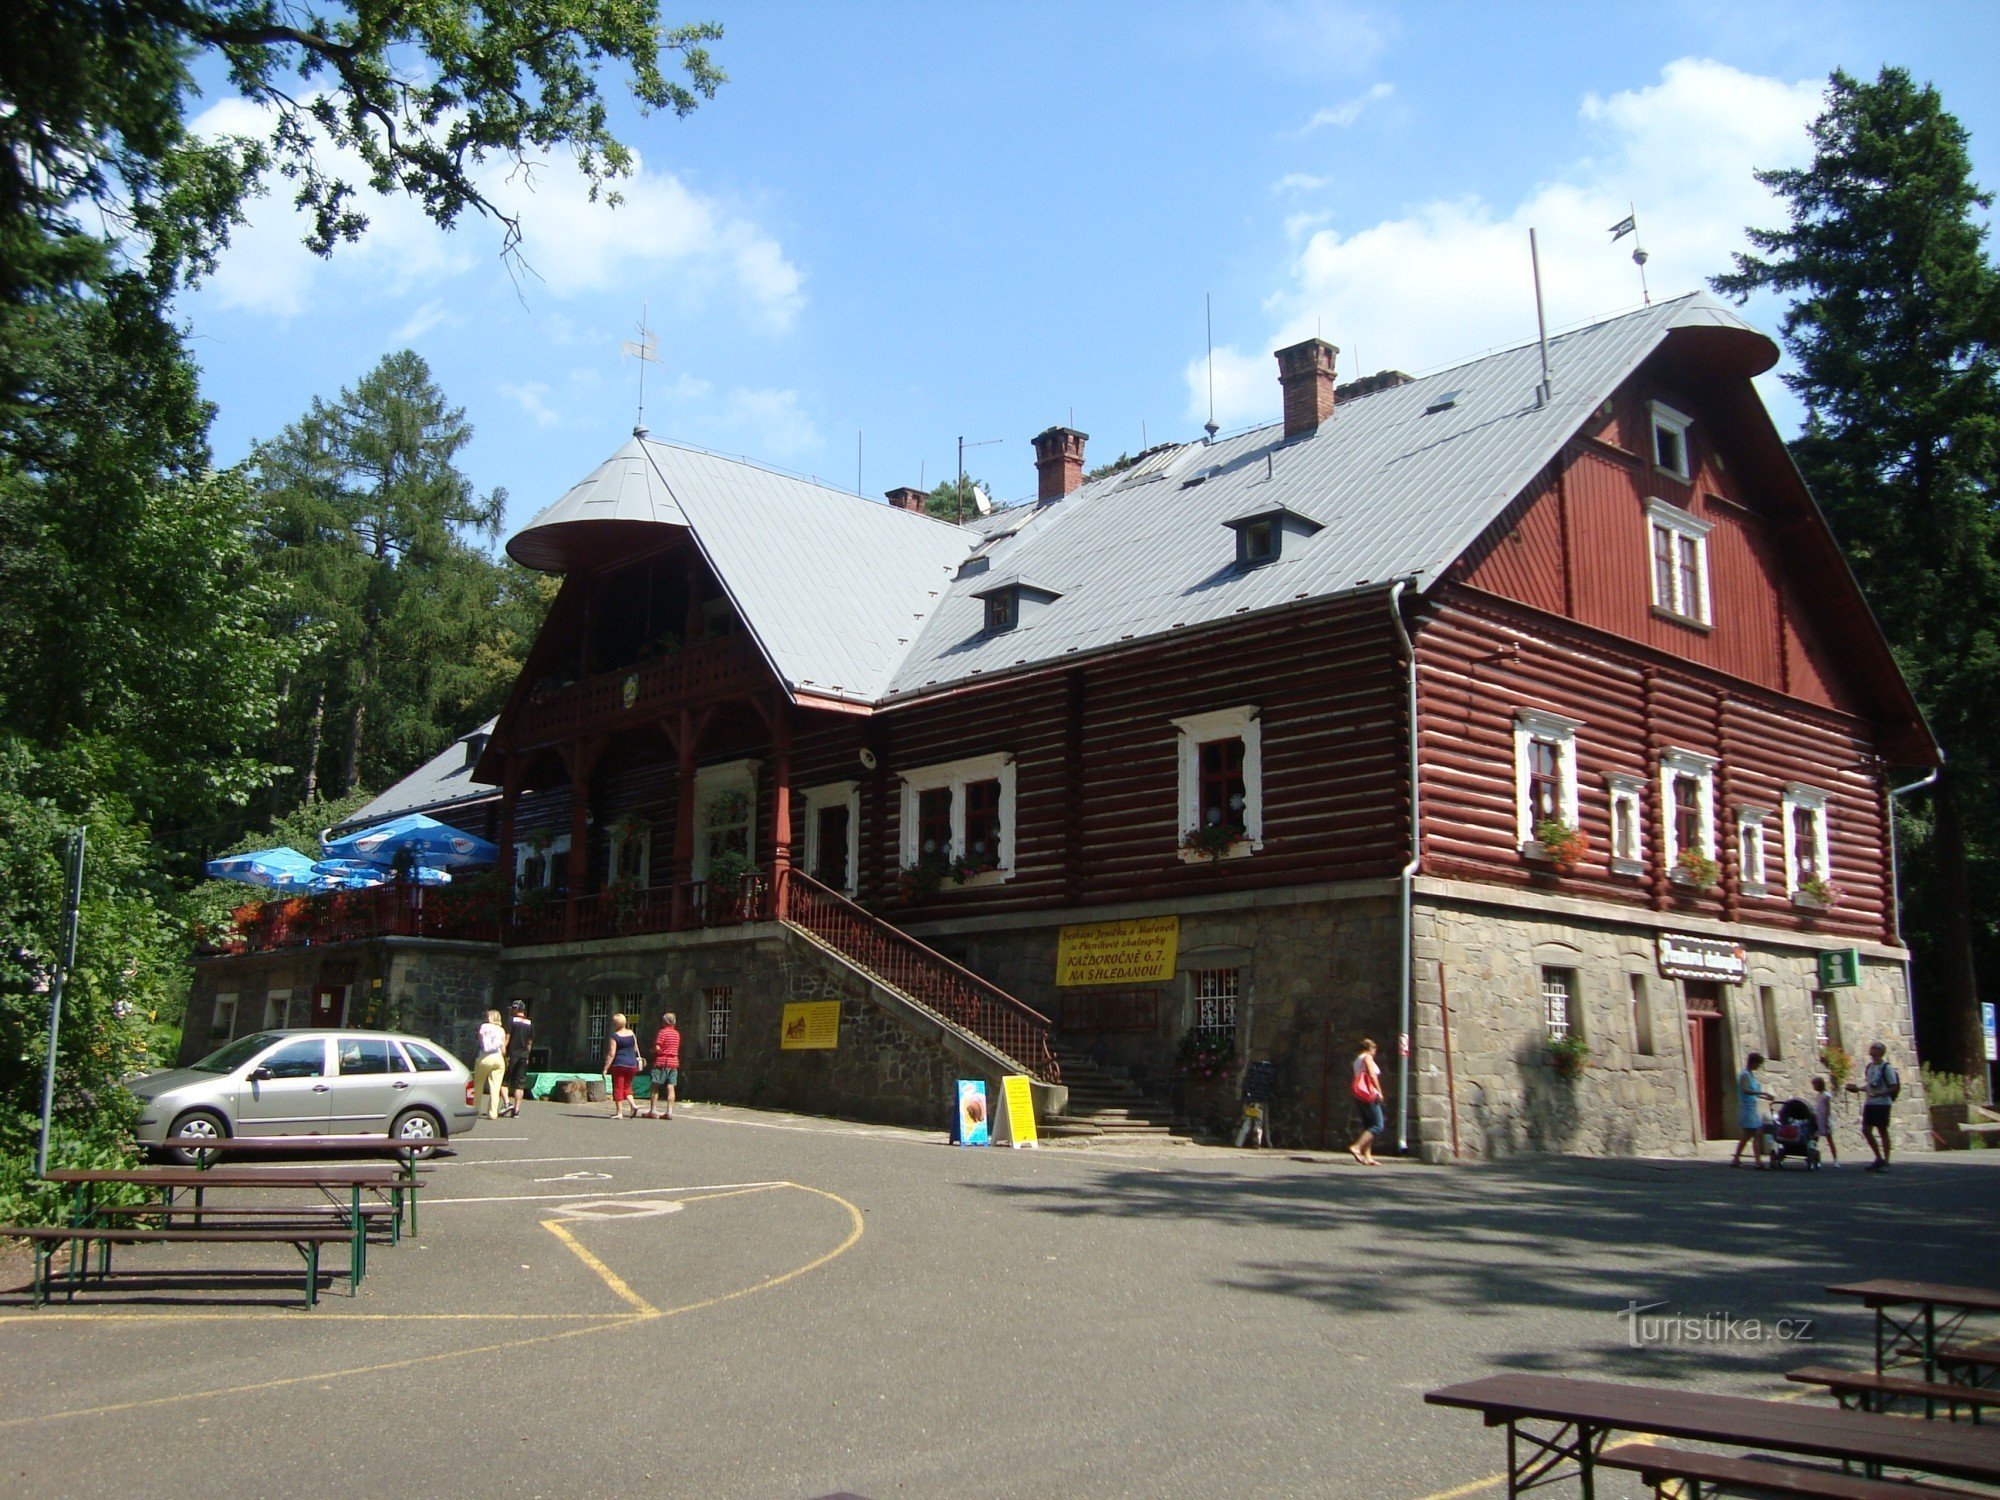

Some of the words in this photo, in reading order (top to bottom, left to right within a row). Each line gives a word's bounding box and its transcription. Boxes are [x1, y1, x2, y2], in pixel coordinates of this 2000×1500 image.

[1067, 949, 1142, 967] KAŽDOROČNĚ
[1068, 969, 1084, 981] NA
[1088, 964, 1162, 980] SHLEDANOU!
